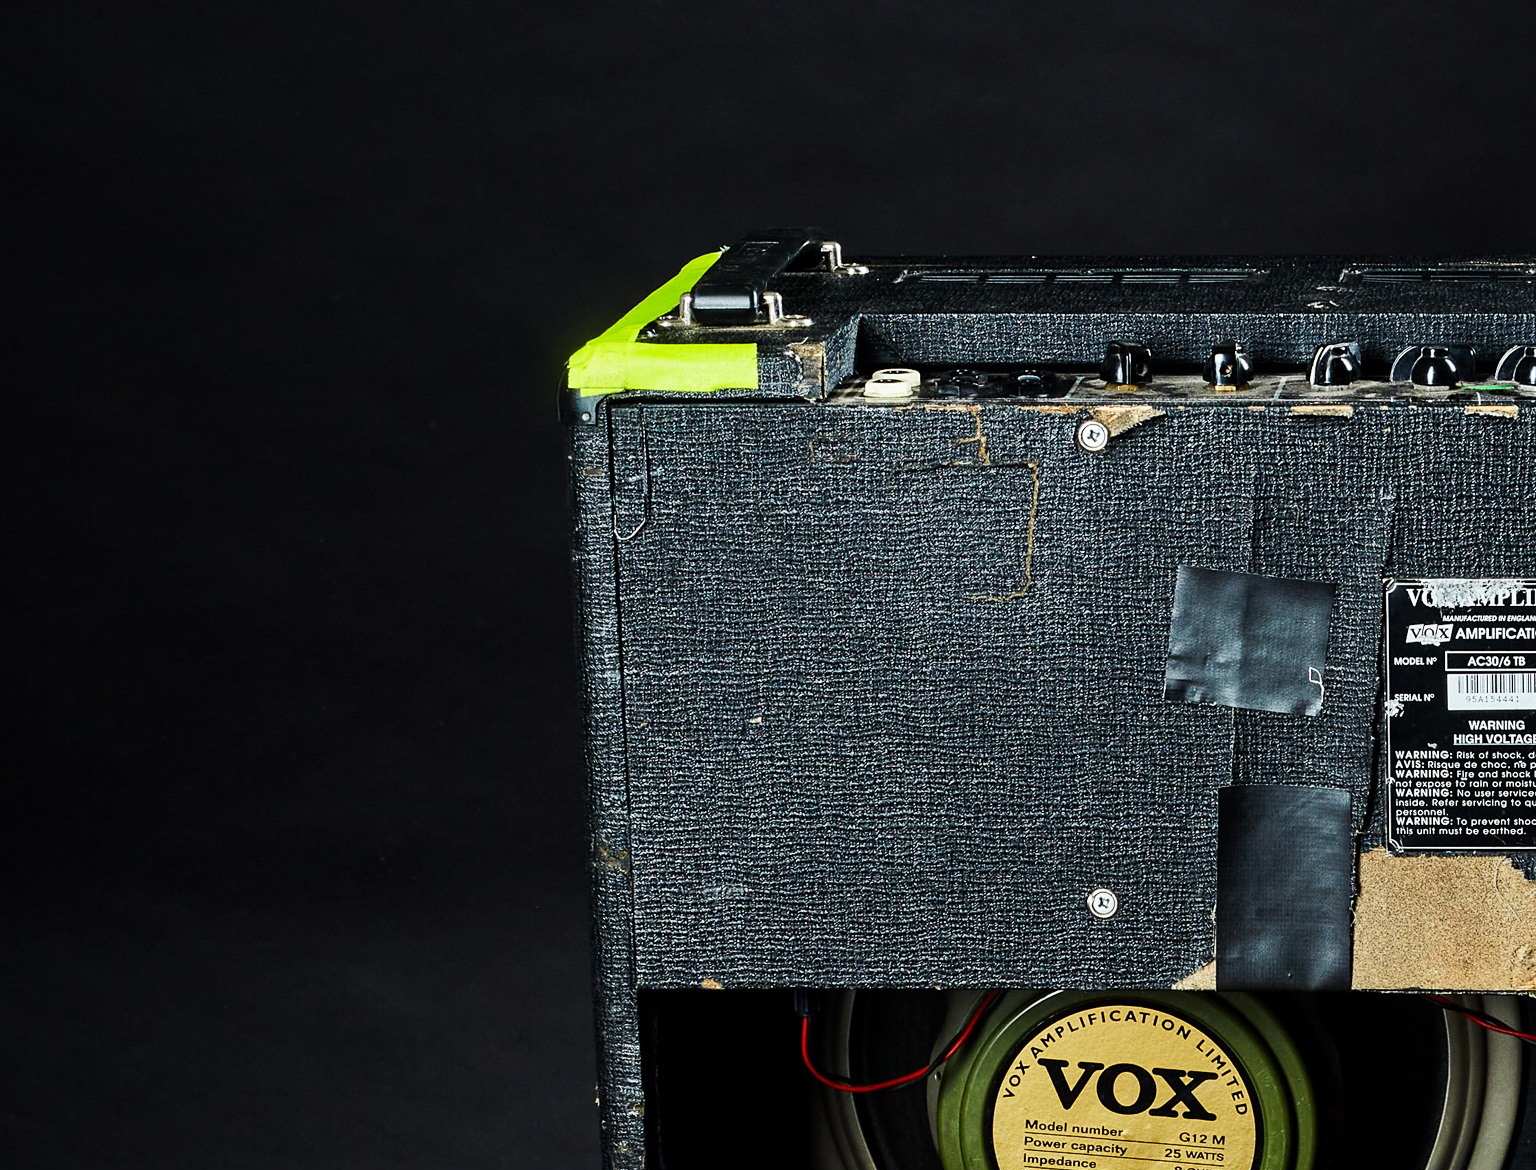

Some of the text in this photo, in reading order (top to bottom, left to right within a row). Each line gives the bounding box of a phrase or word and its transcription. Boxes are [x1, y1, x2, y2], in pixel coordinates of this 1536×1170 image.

[1408, 626, 1451, 641] VOX
[1394, 657, 1425, 666] MODEL
[1467, 656, 1526, 667] AC30/6 TB
[1394, 693, 1422, 702] SERIAL
[1468, 720, 1525, 731] WARNING
[1453, 733, 1483, 744] HIGH
[1395, 751, 1453, 759] WARNING:
[1457, 751, 1475, 759] Risk
[1479, 751, 1488, 759] of
[1492, 751, 1525, 759] shock,
[1395, 760, 1424, 768] AVIS:
[1428, 761, 1460, 769] Risque
[1481, 761, 1511, 769] choc,
[1395, 770, 1453, 778] WARNING:
[1457, 770, 1474, 778] Fire
[1478, 770, 1498, 778] and
[1502, 770, 1530, 778] shock
[1416, 781, 1452, 789] expose
[1396, 789, 1453, 797] WARNING:
[1457, 789, 1470, 797] No
[1462, 799, 1507, 808] servicing
[1396, 808, 1448, 816] personnel.
[1396, 817, 1453, 825] WARNING:
[1471, 818, 1510, 826] prevent
[1397, 827, 1413, 835] this
[1417, 827, 1435, 835] unit
[1466, 827, 1479, 835] be
[1483, 827, 1526, 835] earthed.
[1003, 1010, 1248, 1116] VOX AMPLIFICATION LIMITED
[1037, 1058, 1219, 1121] VOX
[1025, 1119, 1226, 1145] Model number G12 M
[1024, 1136, 1225, 1161] Power capacity 25 WATTS
[1023, 1153, 1097, 1169] Impedance
